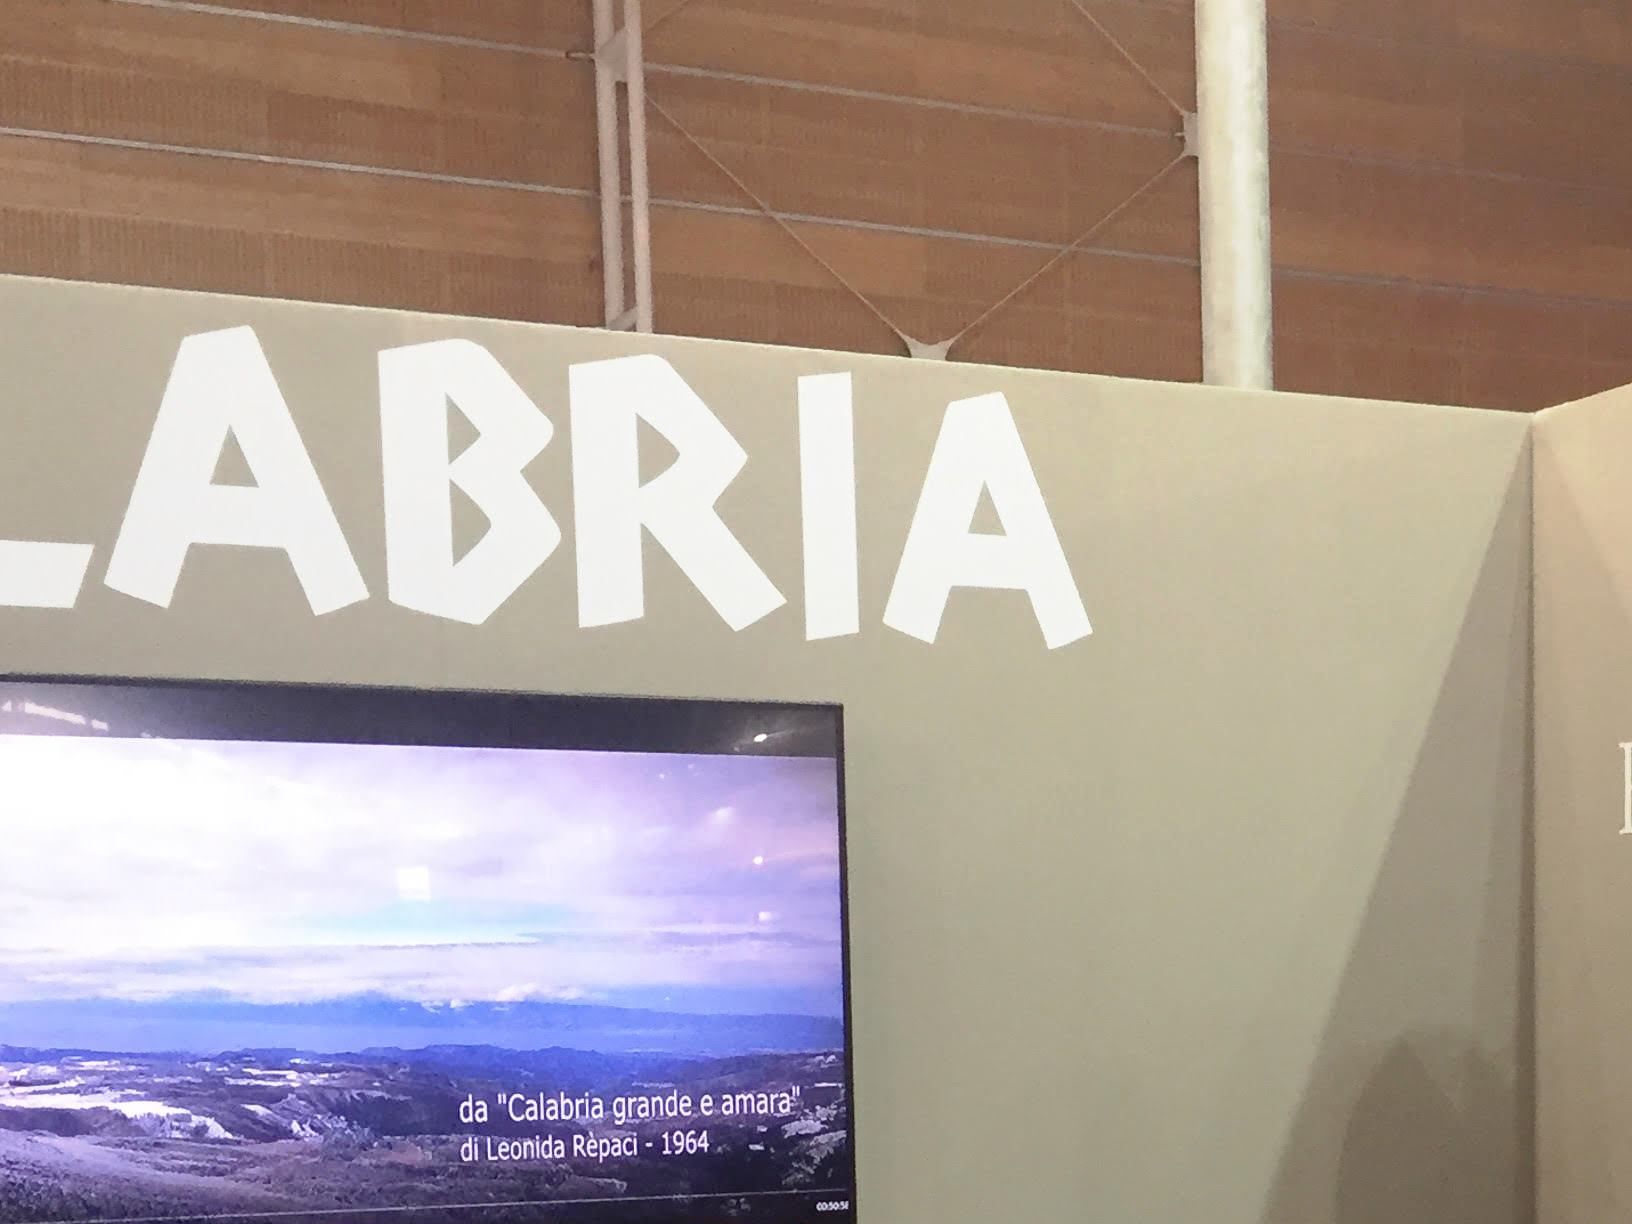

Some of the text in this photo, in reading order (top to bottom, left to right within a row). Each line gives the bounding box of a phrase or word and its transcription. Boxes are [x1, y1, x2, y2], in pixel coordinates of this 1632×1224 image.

[460, 1086, 800, 1125] da "Calabria grande e amara"
[460, 1136, 479, 1161] di
[487, 1133, 565, 1160] Leonida
[574, 1132, 637, 1163] Rèpaci
[662, 1130, 709, 1155] 1964
